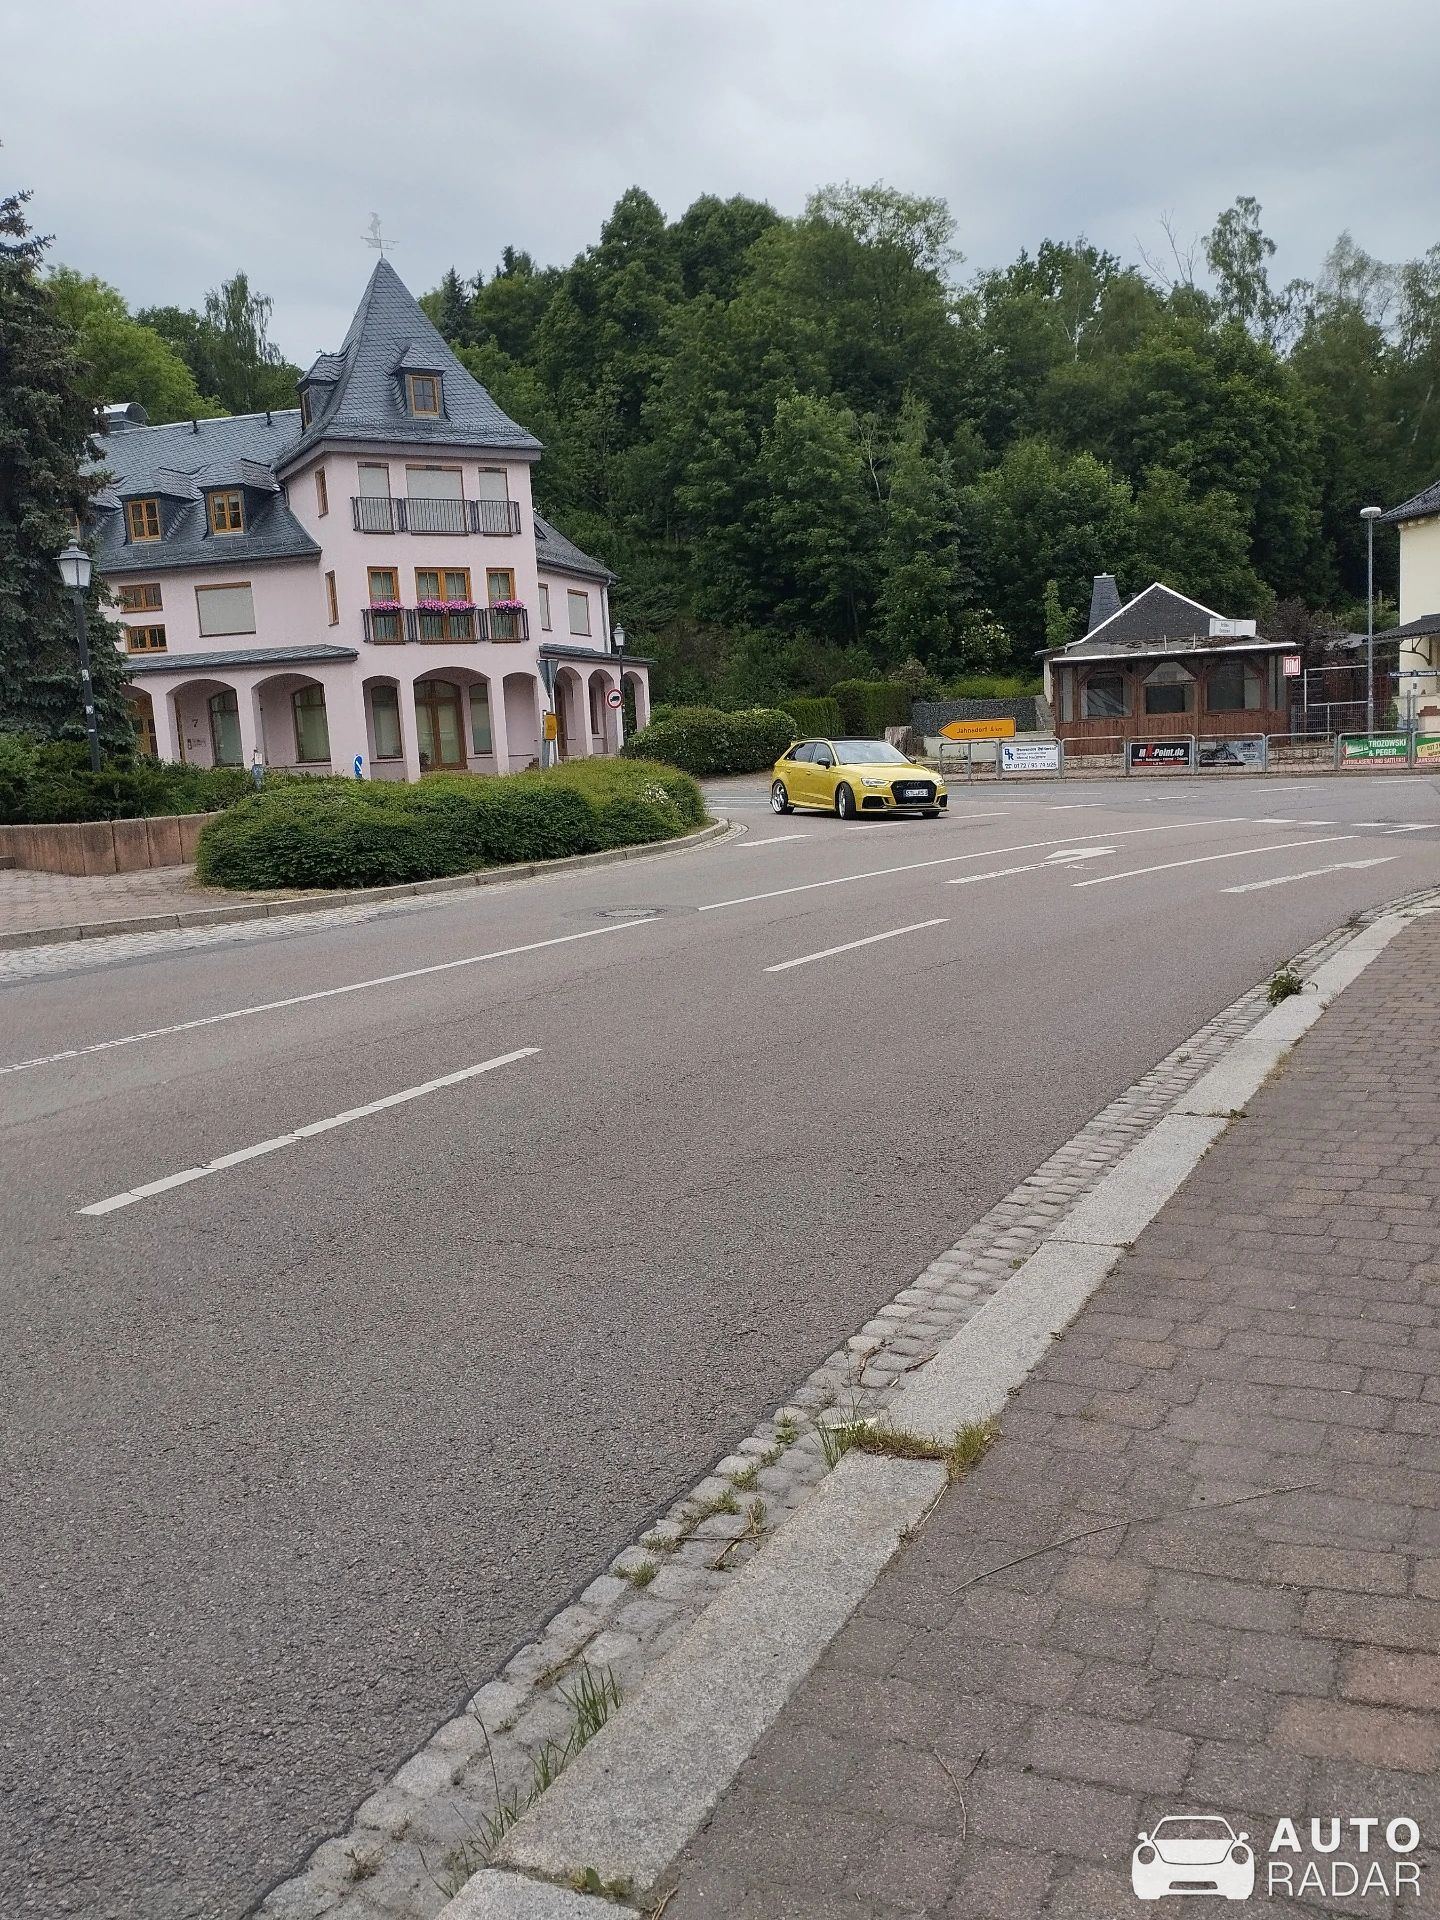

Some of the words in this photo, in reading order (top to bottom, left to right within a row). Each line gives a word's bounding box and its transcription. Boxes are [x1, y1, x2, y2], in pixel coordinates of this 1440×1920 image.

[956, 726, 987, 734] Jahnsdorf
[1368, 738, 1407, 748] TROZOWSKI
[1375, 748, 1397, 757] PEGER
